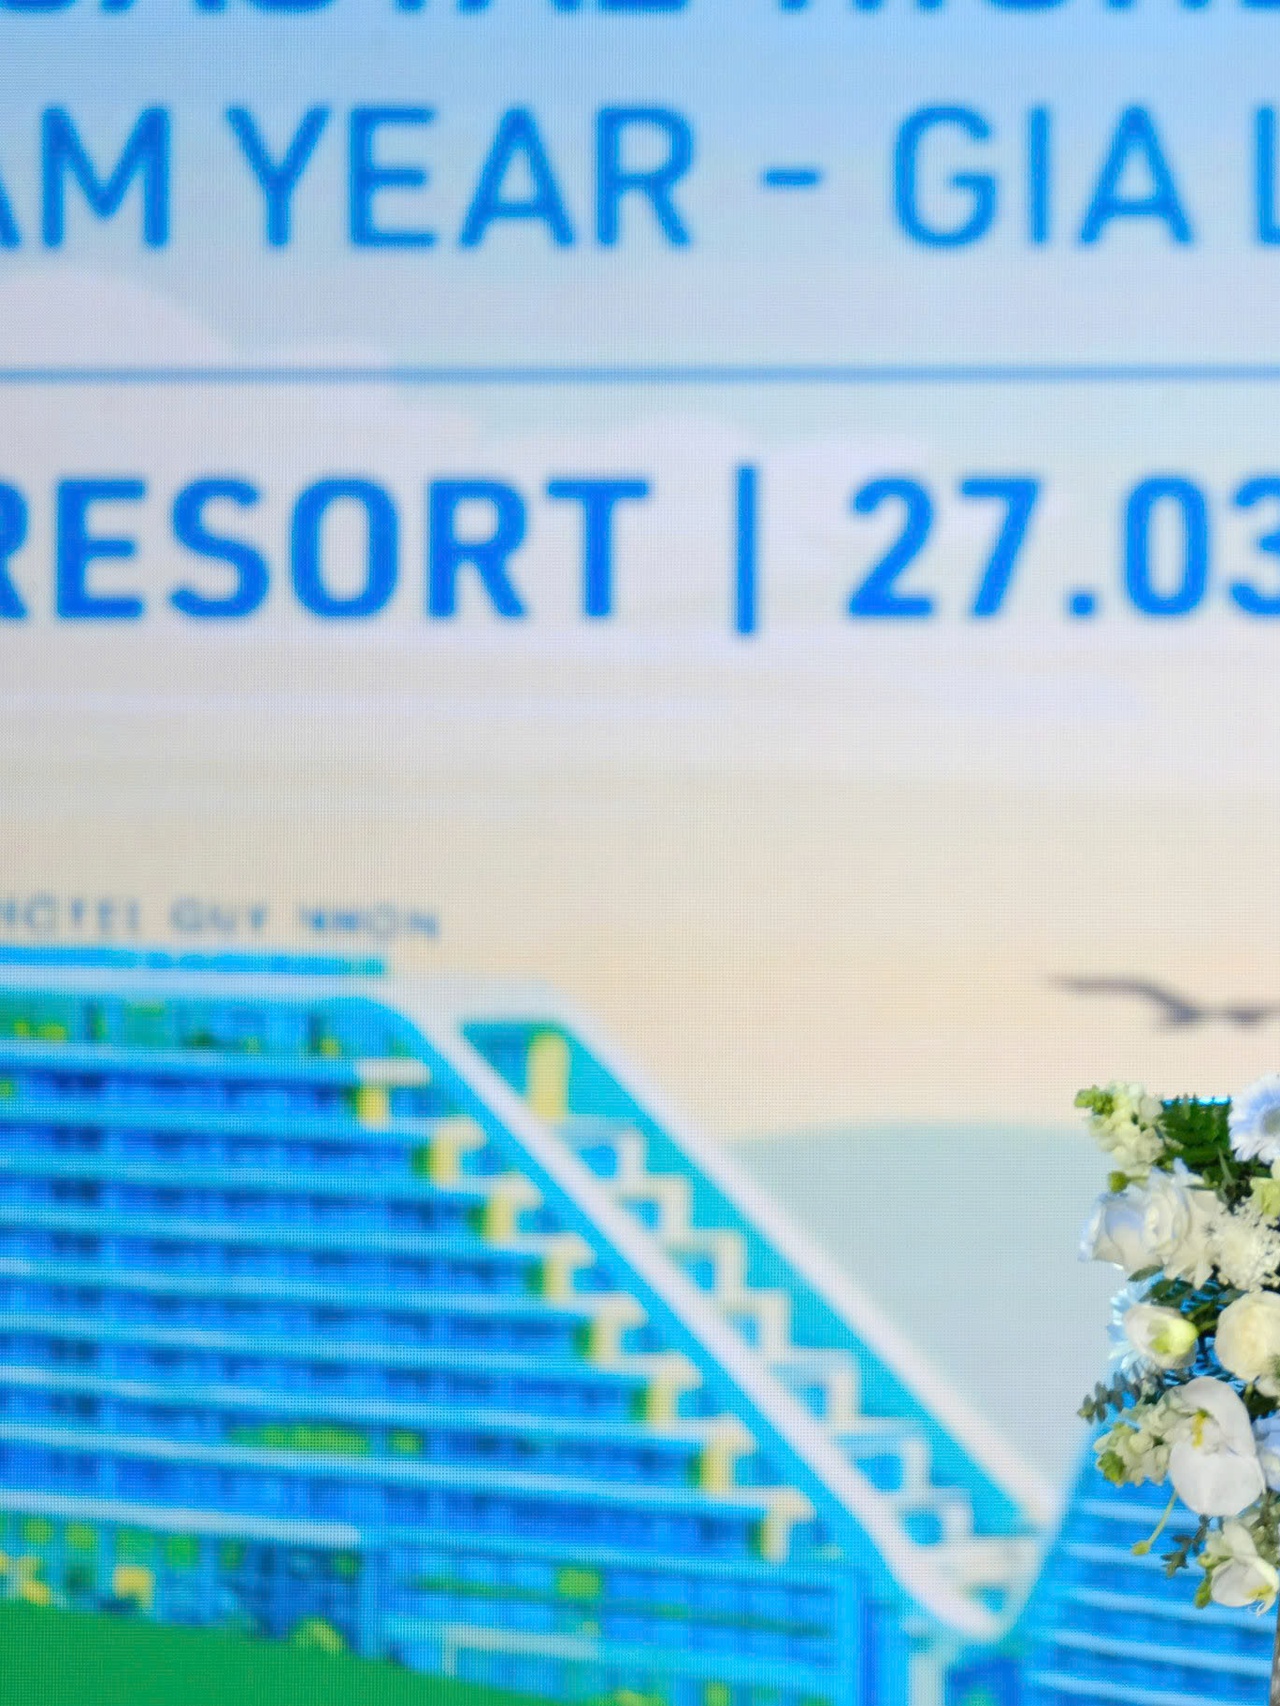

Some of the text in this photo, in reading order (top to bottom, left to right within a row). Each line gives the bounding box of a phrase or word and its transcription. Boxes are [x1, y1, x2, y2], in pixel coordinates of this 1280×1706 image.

[0, 102, 173, 251] M
[222, 102, 698, 251] YEAR
[761, 166, 823, 190] -
[891, 102, 1195, 250] GIA
[0, 477, 651, 621] ESORT
